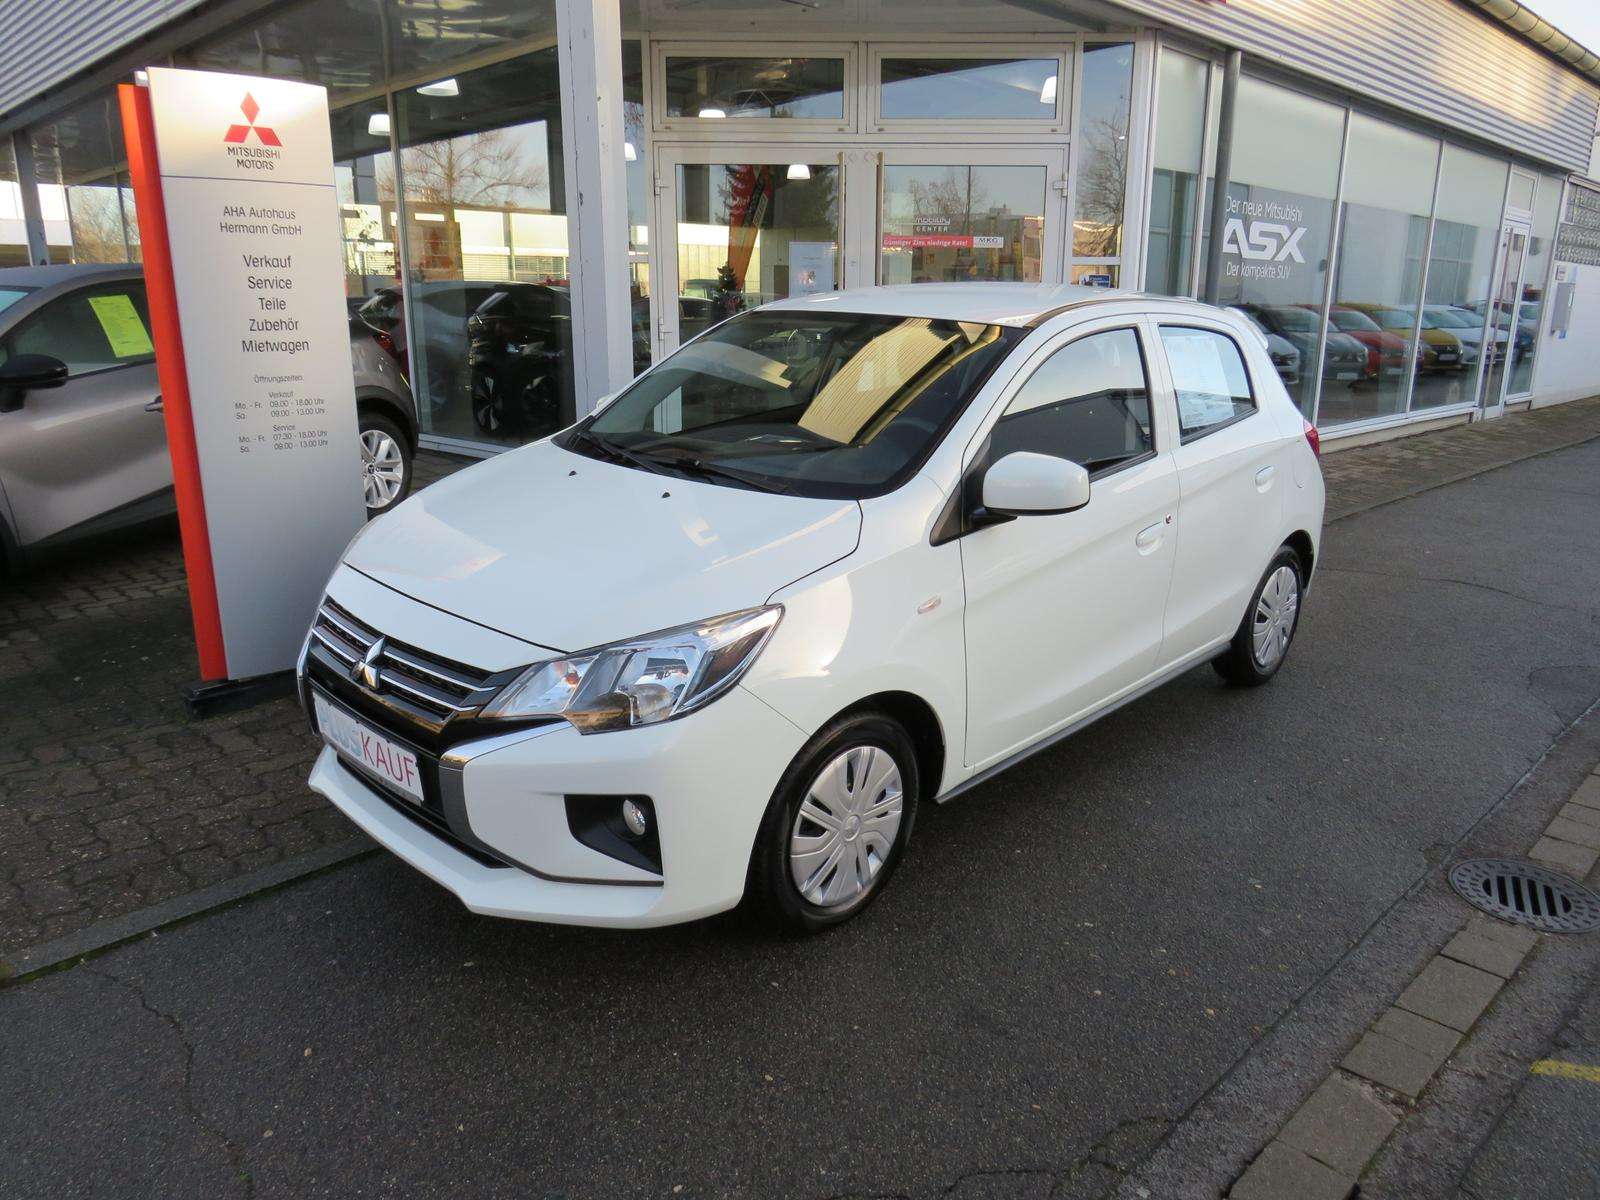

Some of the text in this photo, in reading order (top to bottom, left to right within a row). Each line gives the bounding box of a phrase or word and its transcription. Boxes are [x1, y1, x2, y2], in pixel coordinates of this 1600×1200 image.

[227, 146, 281, 159] MITSUBISHI
[236, 159, 275, 171] MOTORS
[223, 206, 296, 220] AHA Autohaus
[1242, 199, 1262, 216] neue
[1264, 202, 1303, 222] Mitsubishi
[220, 222, 302, 236] Hermann GmbH
[915, 225, 949, 233] CENTER
[927, 239, 951, 248] niedrige
[952, 239, 968, 247] Rate!
[1222, 217, 1308, 264] ASX
[242, 254, 292, 268] Verkauf
[1226, 261, 1291, 280] Der kompakte SUV
[247, 275, 293, 290] Service
[258, 297, 287, 311] Teile
[248, 317, 299, 332] Zubehör
[241, 340, 309, 355] Mietwagen
[268, 391, 294, 399] Verkauf
[272, 424, 296, 432] Service
